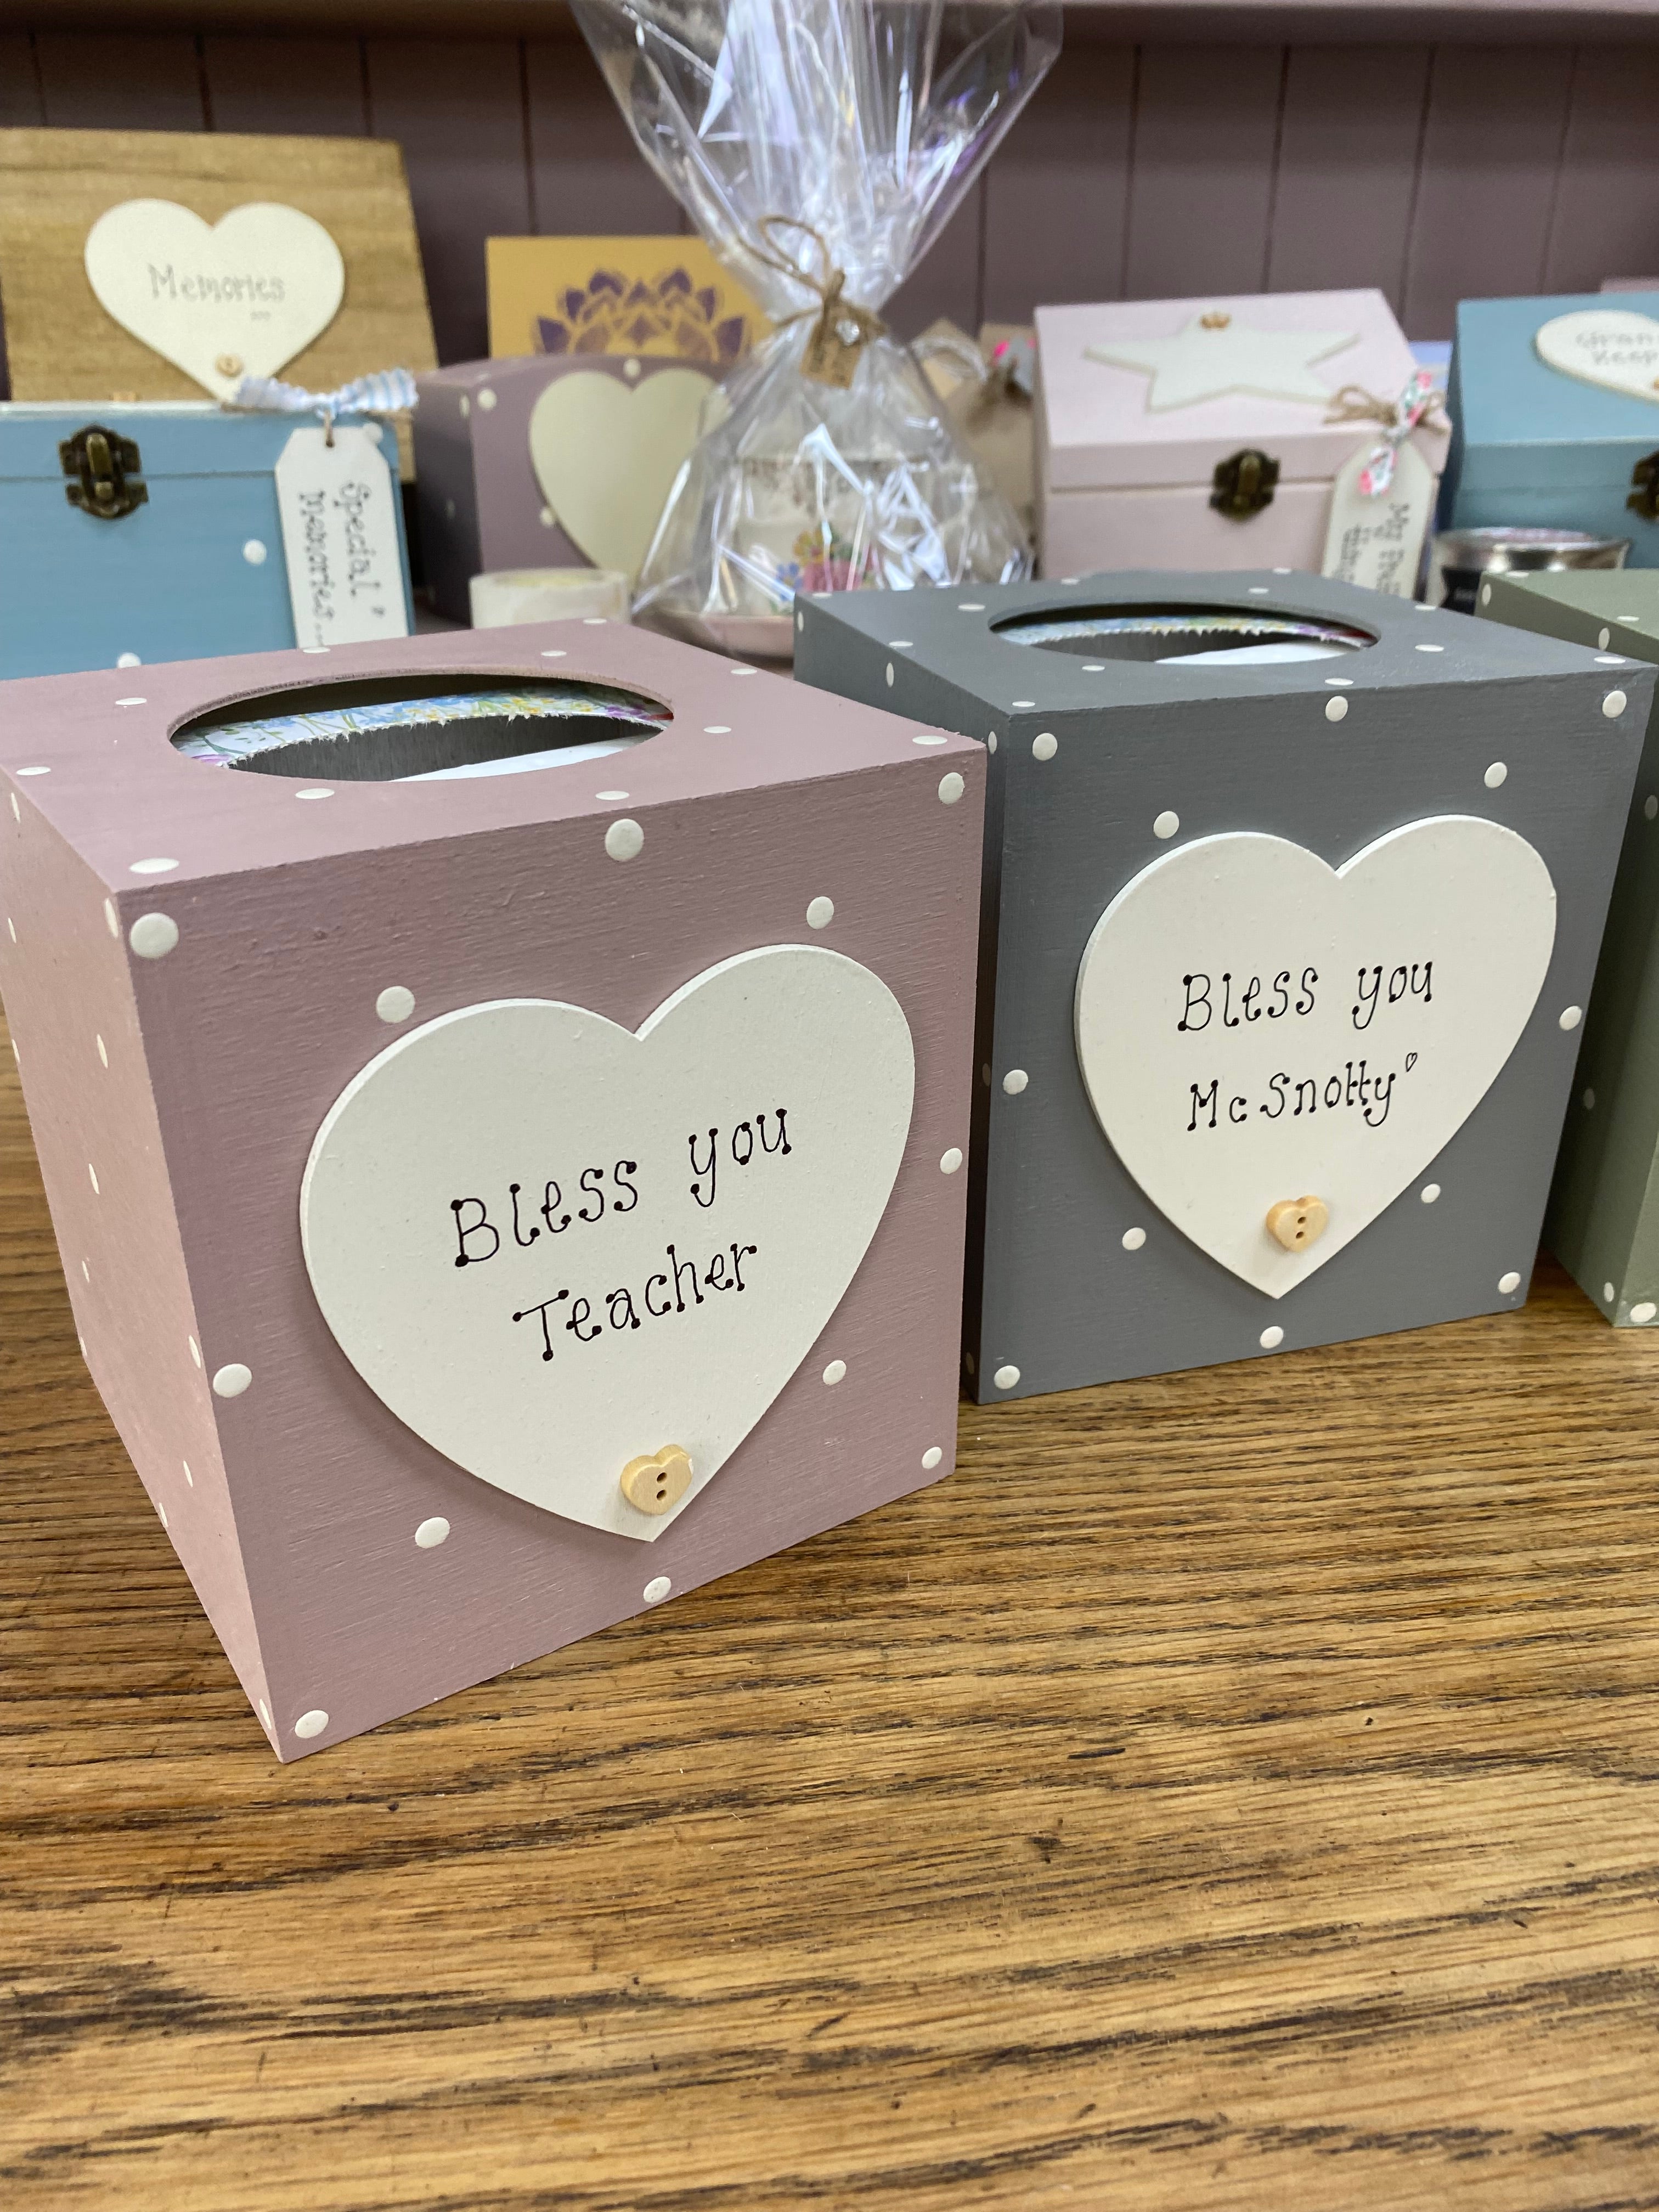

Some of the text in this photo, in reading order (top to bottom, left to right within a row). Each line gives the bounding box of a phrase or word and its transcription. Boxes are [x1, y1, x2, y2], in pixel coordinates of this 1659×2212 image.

[146, 262, 286, 303] Memories
[332, 482, 381, 597] Special
[1177, 961, 1433, 1031] Bless you
[450, 1107, 792, 1268] Bless you
[511, 1242, 758, 1362] Teacher
